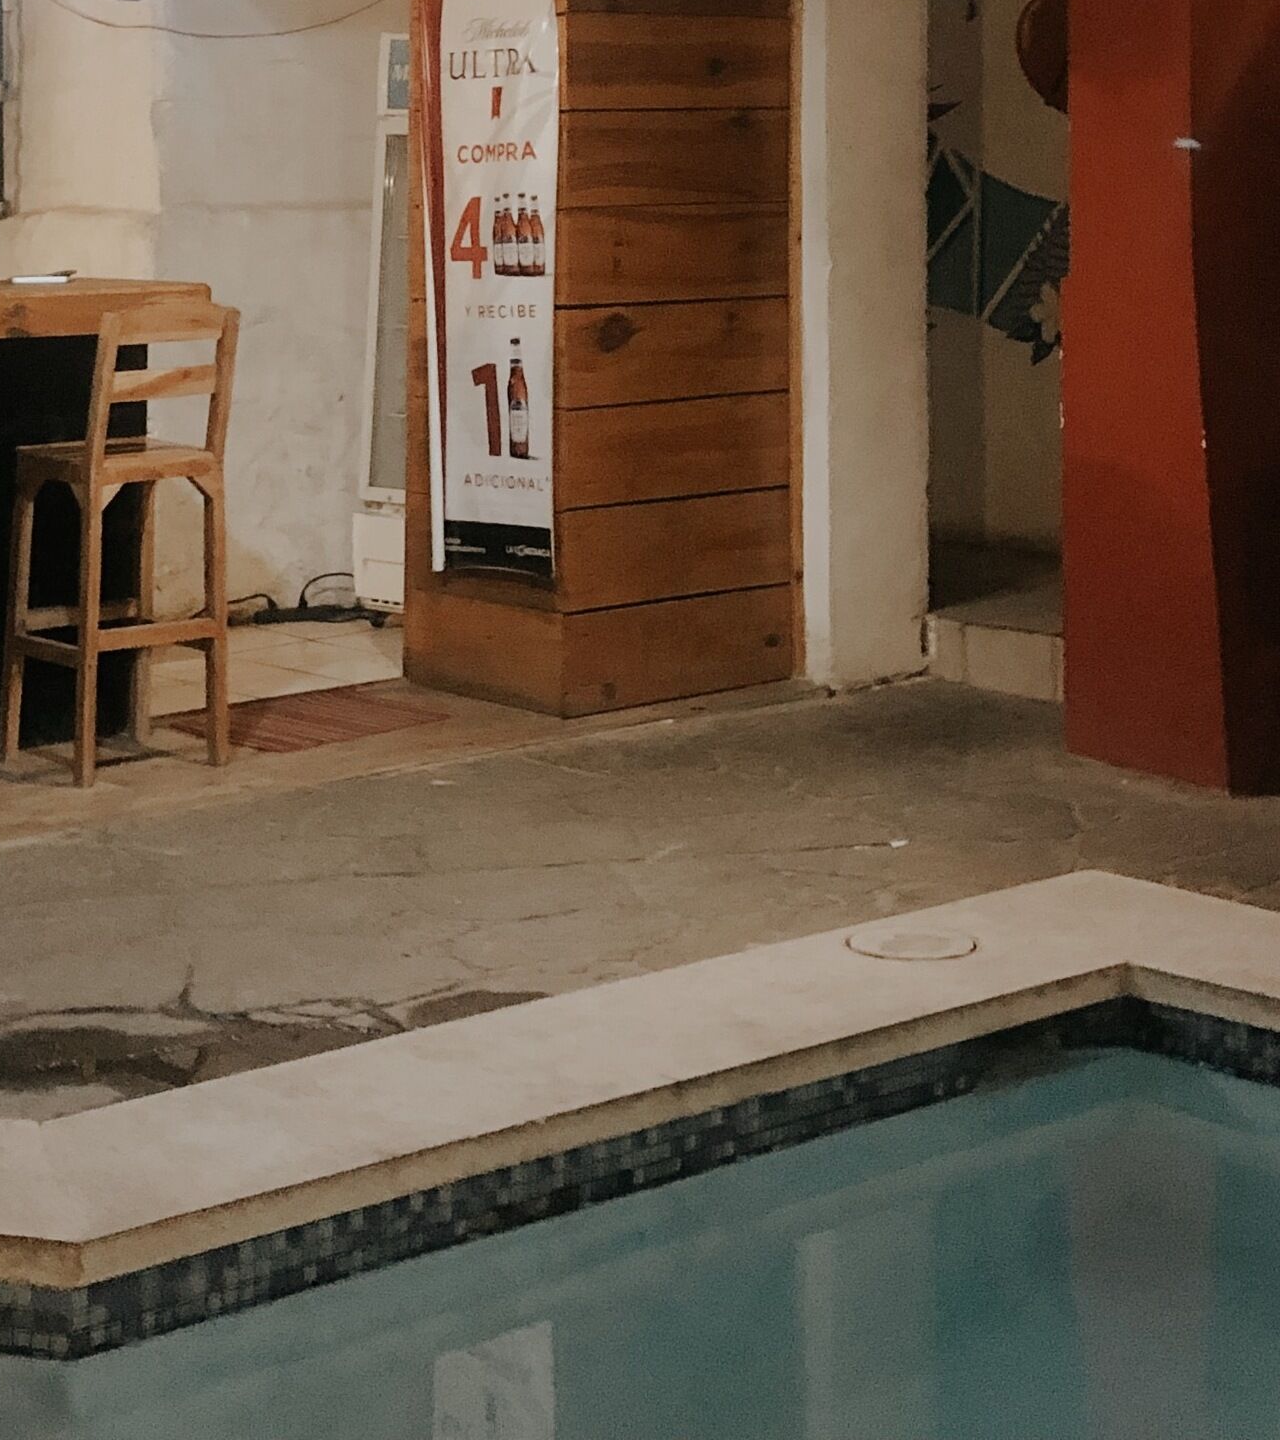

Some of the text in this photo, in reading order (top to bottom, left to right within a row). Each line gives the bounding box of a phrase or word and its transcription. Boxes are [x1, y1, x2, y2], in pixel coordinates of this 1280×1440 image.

[449, 48, 537, 80] ULTRA
[457, 141, 537, 164] COMPRA
[450, 196, 488, 279] 4
[464, 304, 537, 319] Y RECIBE
[471, 363, 501, 456] 1
